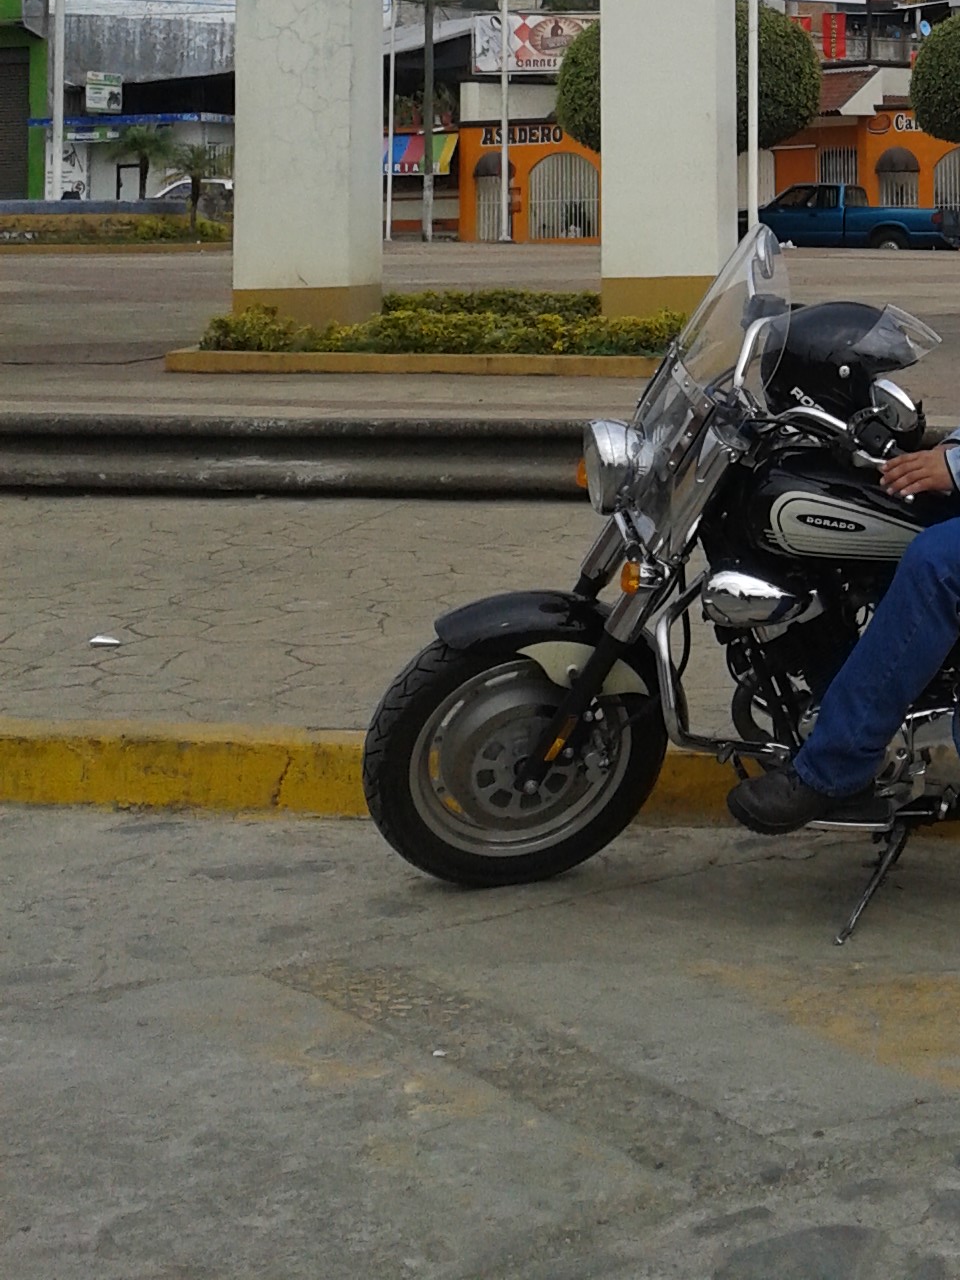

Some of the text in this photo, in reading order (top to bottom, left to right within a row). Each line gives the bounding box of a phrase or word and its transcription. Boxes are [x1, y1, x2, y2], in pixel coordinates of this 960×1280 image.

[516, 58, 558, 68] CARNES
[481, 125, 564, 146] ASADERO
[806, 516, 857, 531] DORADO
